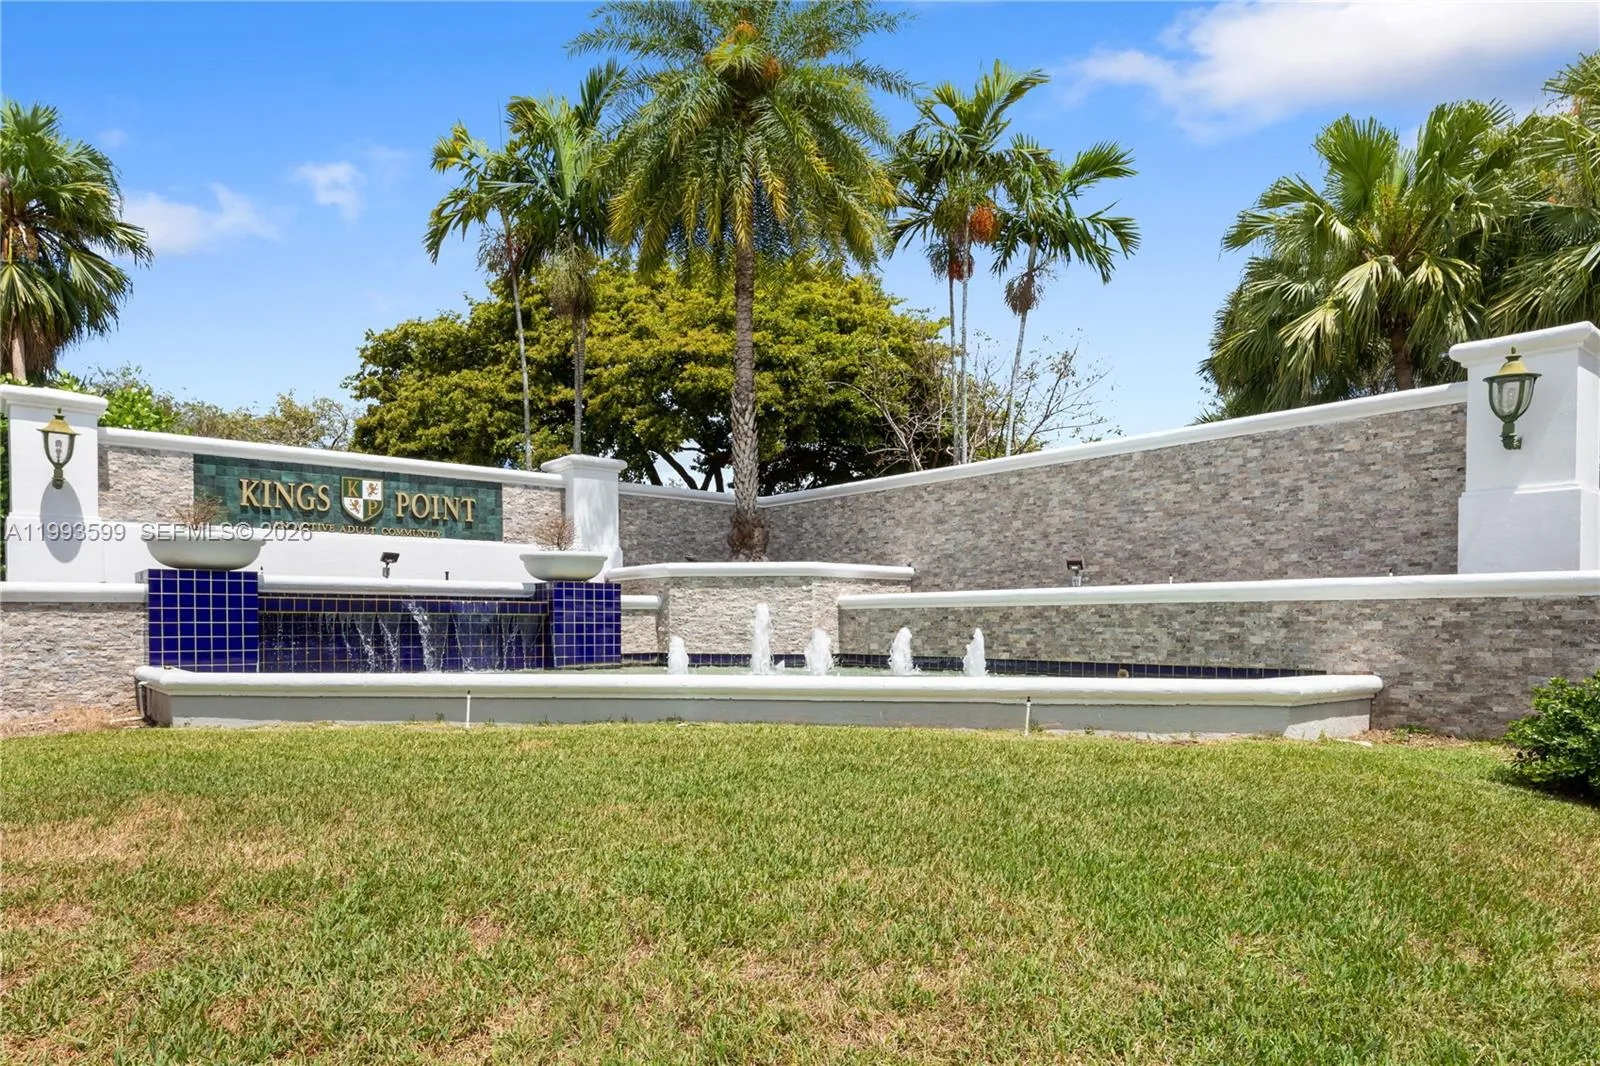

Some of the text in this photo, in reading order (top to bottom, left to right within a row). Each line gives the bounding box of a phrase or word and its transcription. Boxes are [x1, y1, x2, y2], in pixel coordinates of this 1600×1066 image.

[347, 480, 359, 497] K
[239, 478, 476, 523] KINGS POINT
[367, 500, 378, 516] P
[295, 522, 336, 532] CTIVE
[339, 525, 377, 534] ADULT
[381, 527, 442, 538] COMMUNITY
